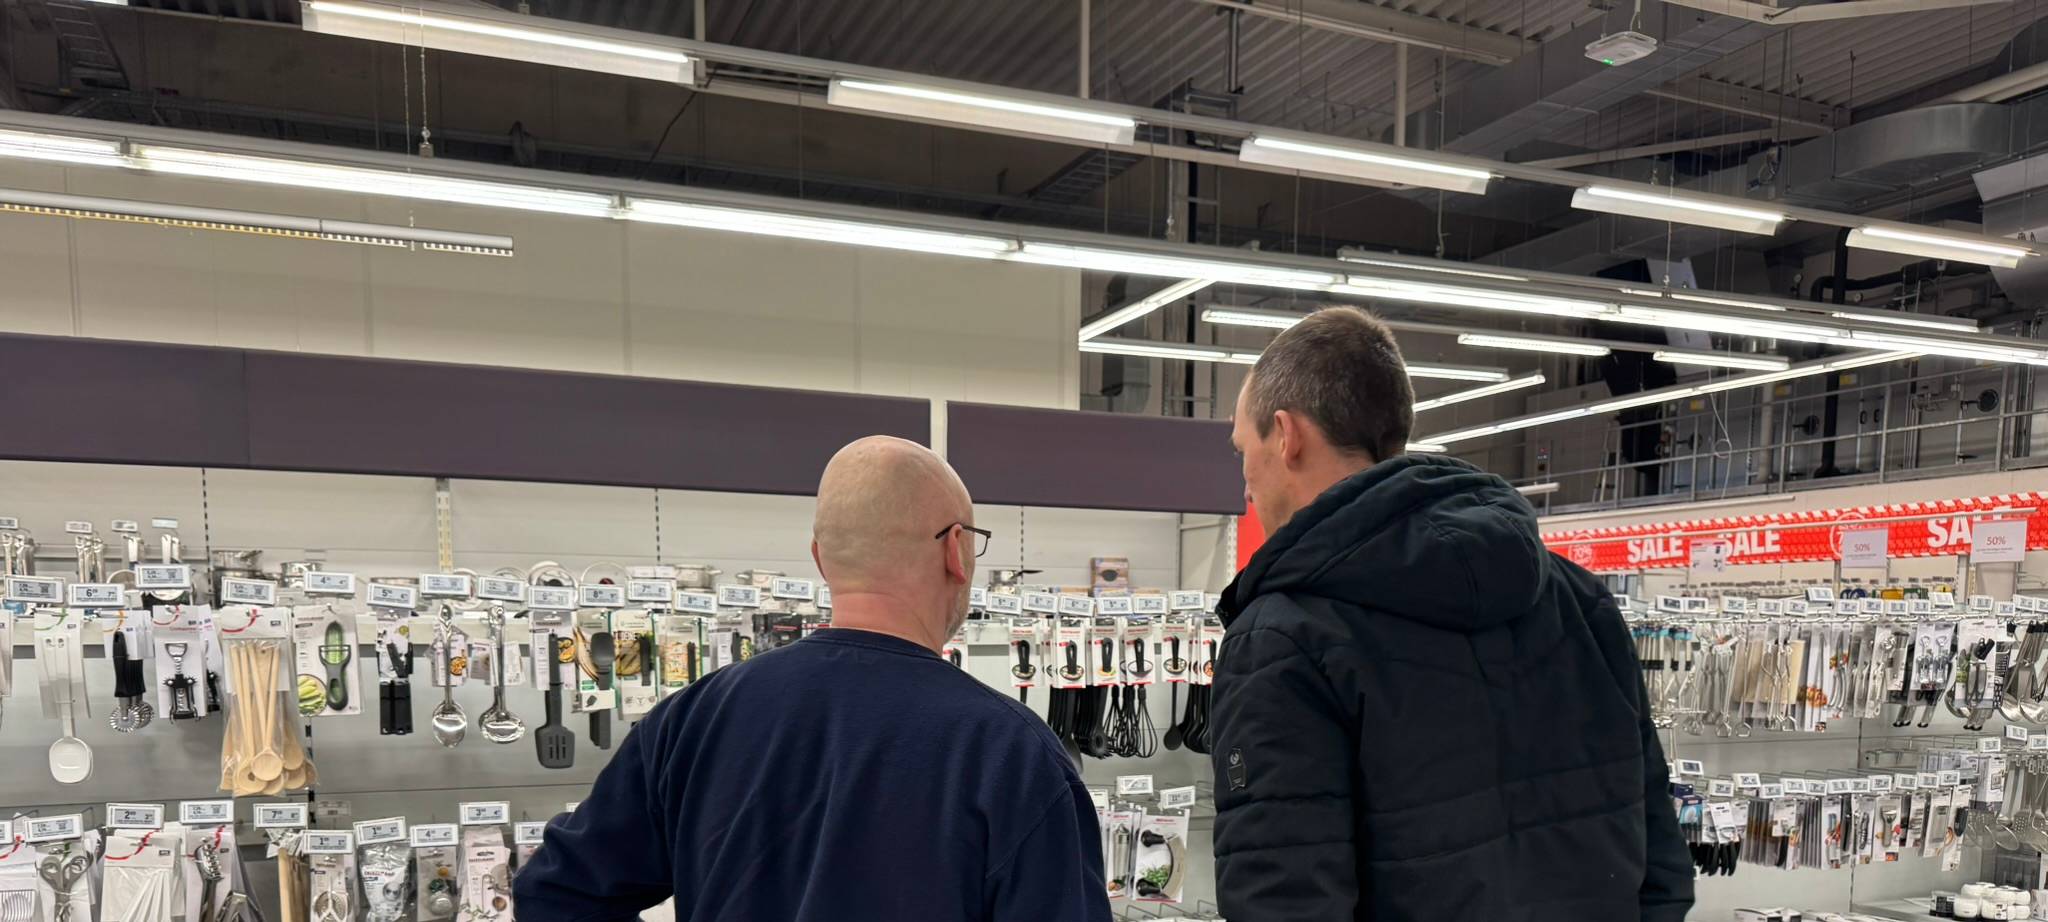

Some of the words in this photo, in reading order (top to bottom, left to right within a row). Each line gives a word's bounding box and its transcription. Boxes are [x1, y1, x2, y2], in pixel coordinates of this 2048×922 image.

[1627, 531, 1683, 563] SALE
[1718, 525, 1781, 558] SALE
[1854, 543, 1871, 552] 50%
[1986, 536, 2006, 546] 50%
